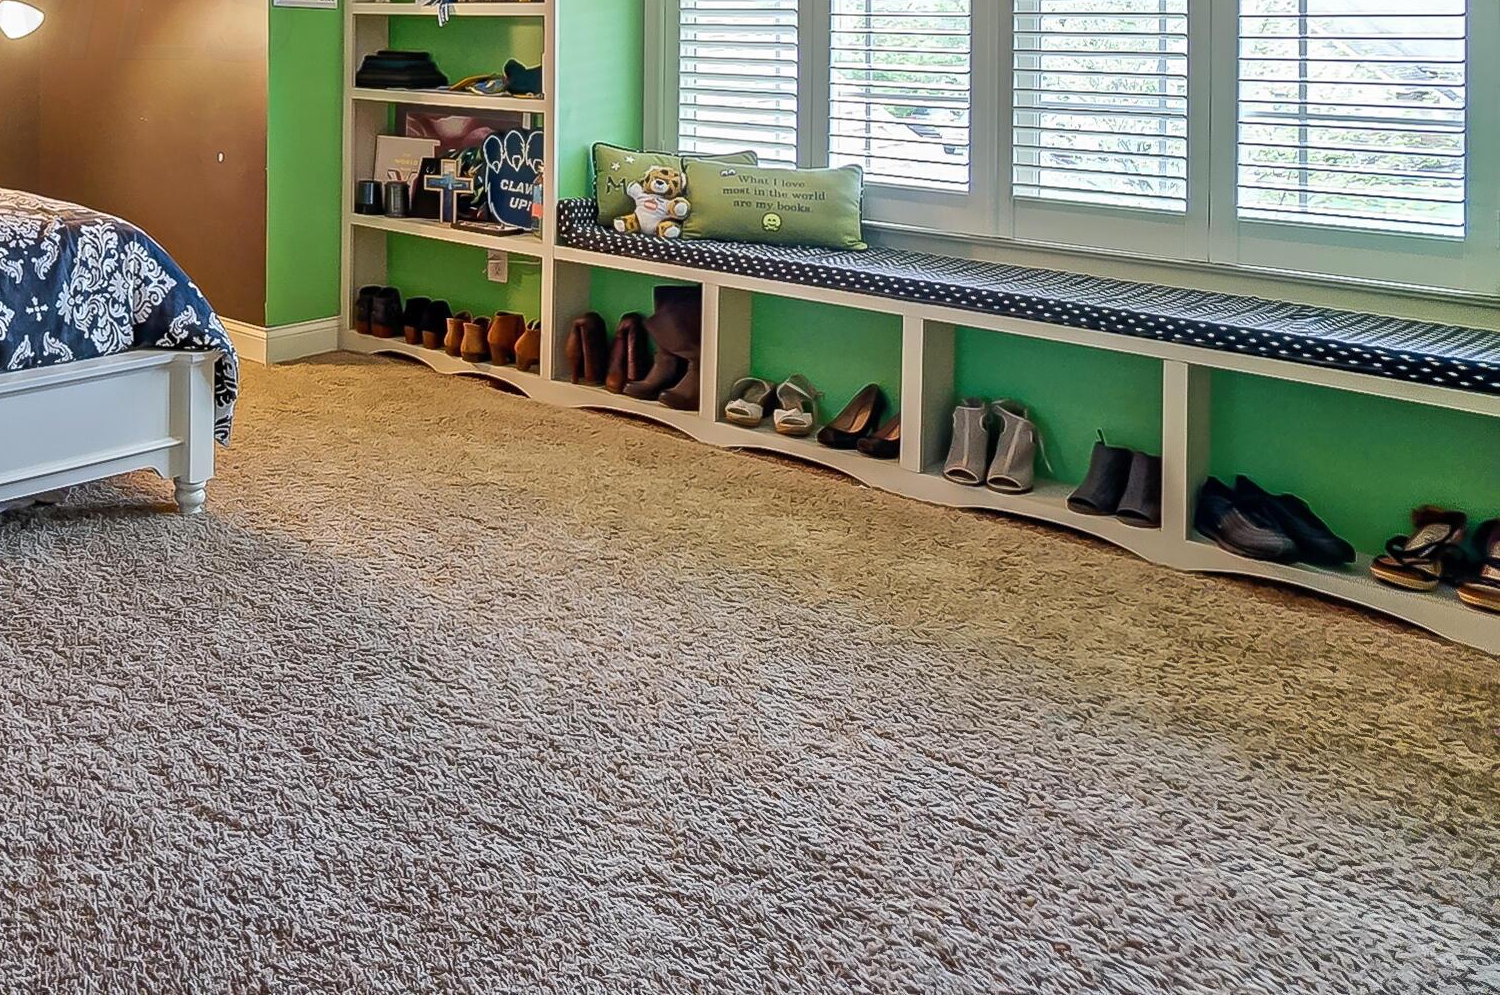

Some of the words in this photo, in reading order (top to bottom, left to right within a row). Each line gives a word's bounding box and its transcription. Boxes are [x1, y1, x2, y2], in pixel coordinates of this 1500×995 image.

[500, 179, 533, 195] CLAW
[738, 174, 769, 185] What
[773, 178, 778, 186] I
[781, 179, 805, 188] love
[722, 186, 750, 195] most
[754, 187, 765, 196] in
[769, 189, 788, 198] the
[792, 191, 826, 201] world
[733, 199, 752, 208] are
[755, 201, 774, 211] my
